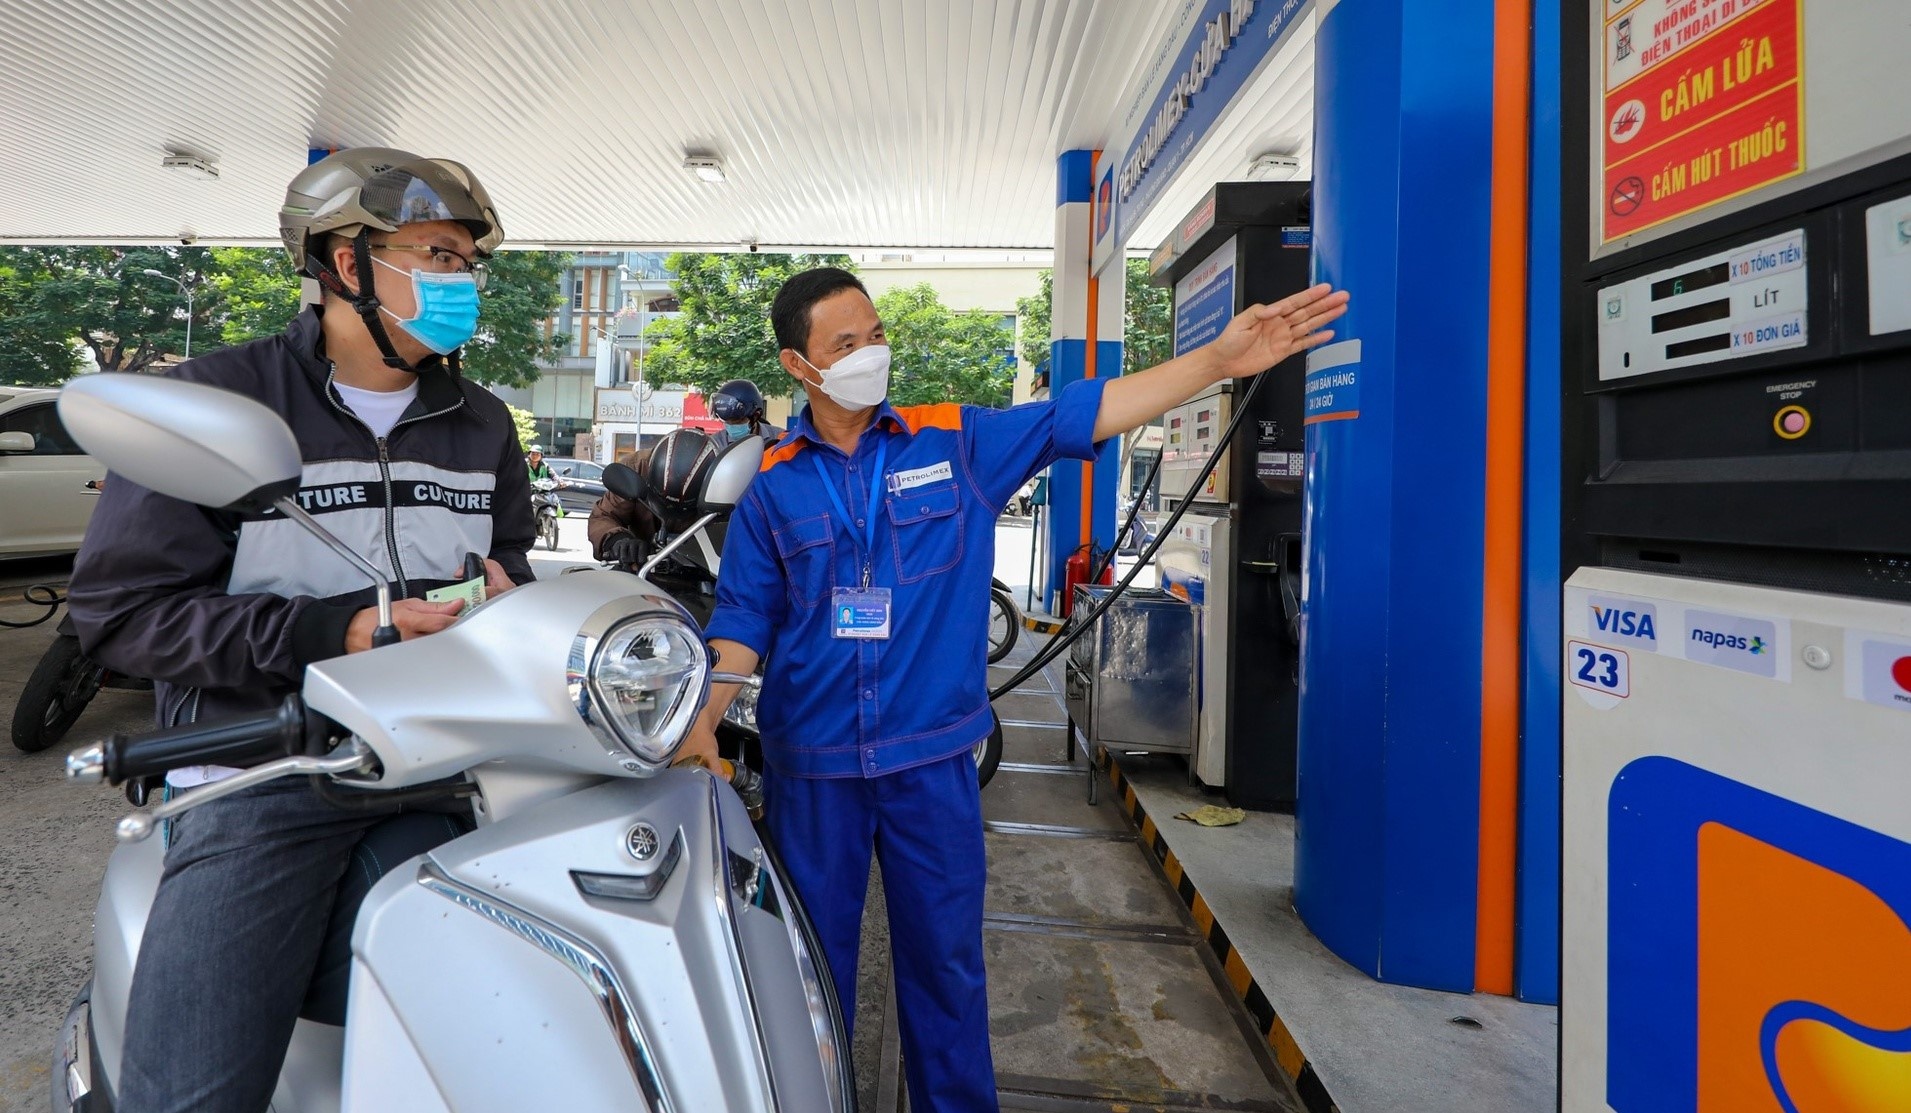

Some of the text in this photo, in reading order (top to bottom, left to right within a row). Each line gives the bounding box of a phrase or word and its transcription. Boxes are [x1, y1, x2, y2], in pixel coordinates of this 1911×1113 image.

[1641, 37, 1672, 67] ĐIỆN
[1677, 9, 1717, 46] THOẠI
[1660, 36, 1774, 122] CẤM LỬA
[1652, 116, 1787, 202] CẤM HÚT THUỐC
[1740, 262, 1749, 276] 10
[1750, 249, 1776, 272] TỔNG
[1754, 288, 1779, 308] LÍT
[1743, 331, 1754, 345] 10
[1756, 325, 1779, 342] ĐƠN
[1782, 319, 1801, 338] GIÁ
[1332, 371, 1355, 387] HÀNG
[1766, 380, 1817, 393] EMERGENCY
[1321, 391, 1334, 407] GIỜ
[1780, 391, 1802, 400] STOP
[600, 402, 637, 417] BÁNH
[659, 405, 681, 418] 362
[902, 467, 949, 482] PETROLIMEX
[1590, 605, 1656, 640] VISA
[1691, 627, 1747, 650] napas
[1577, 648, 1619, 688] 23
